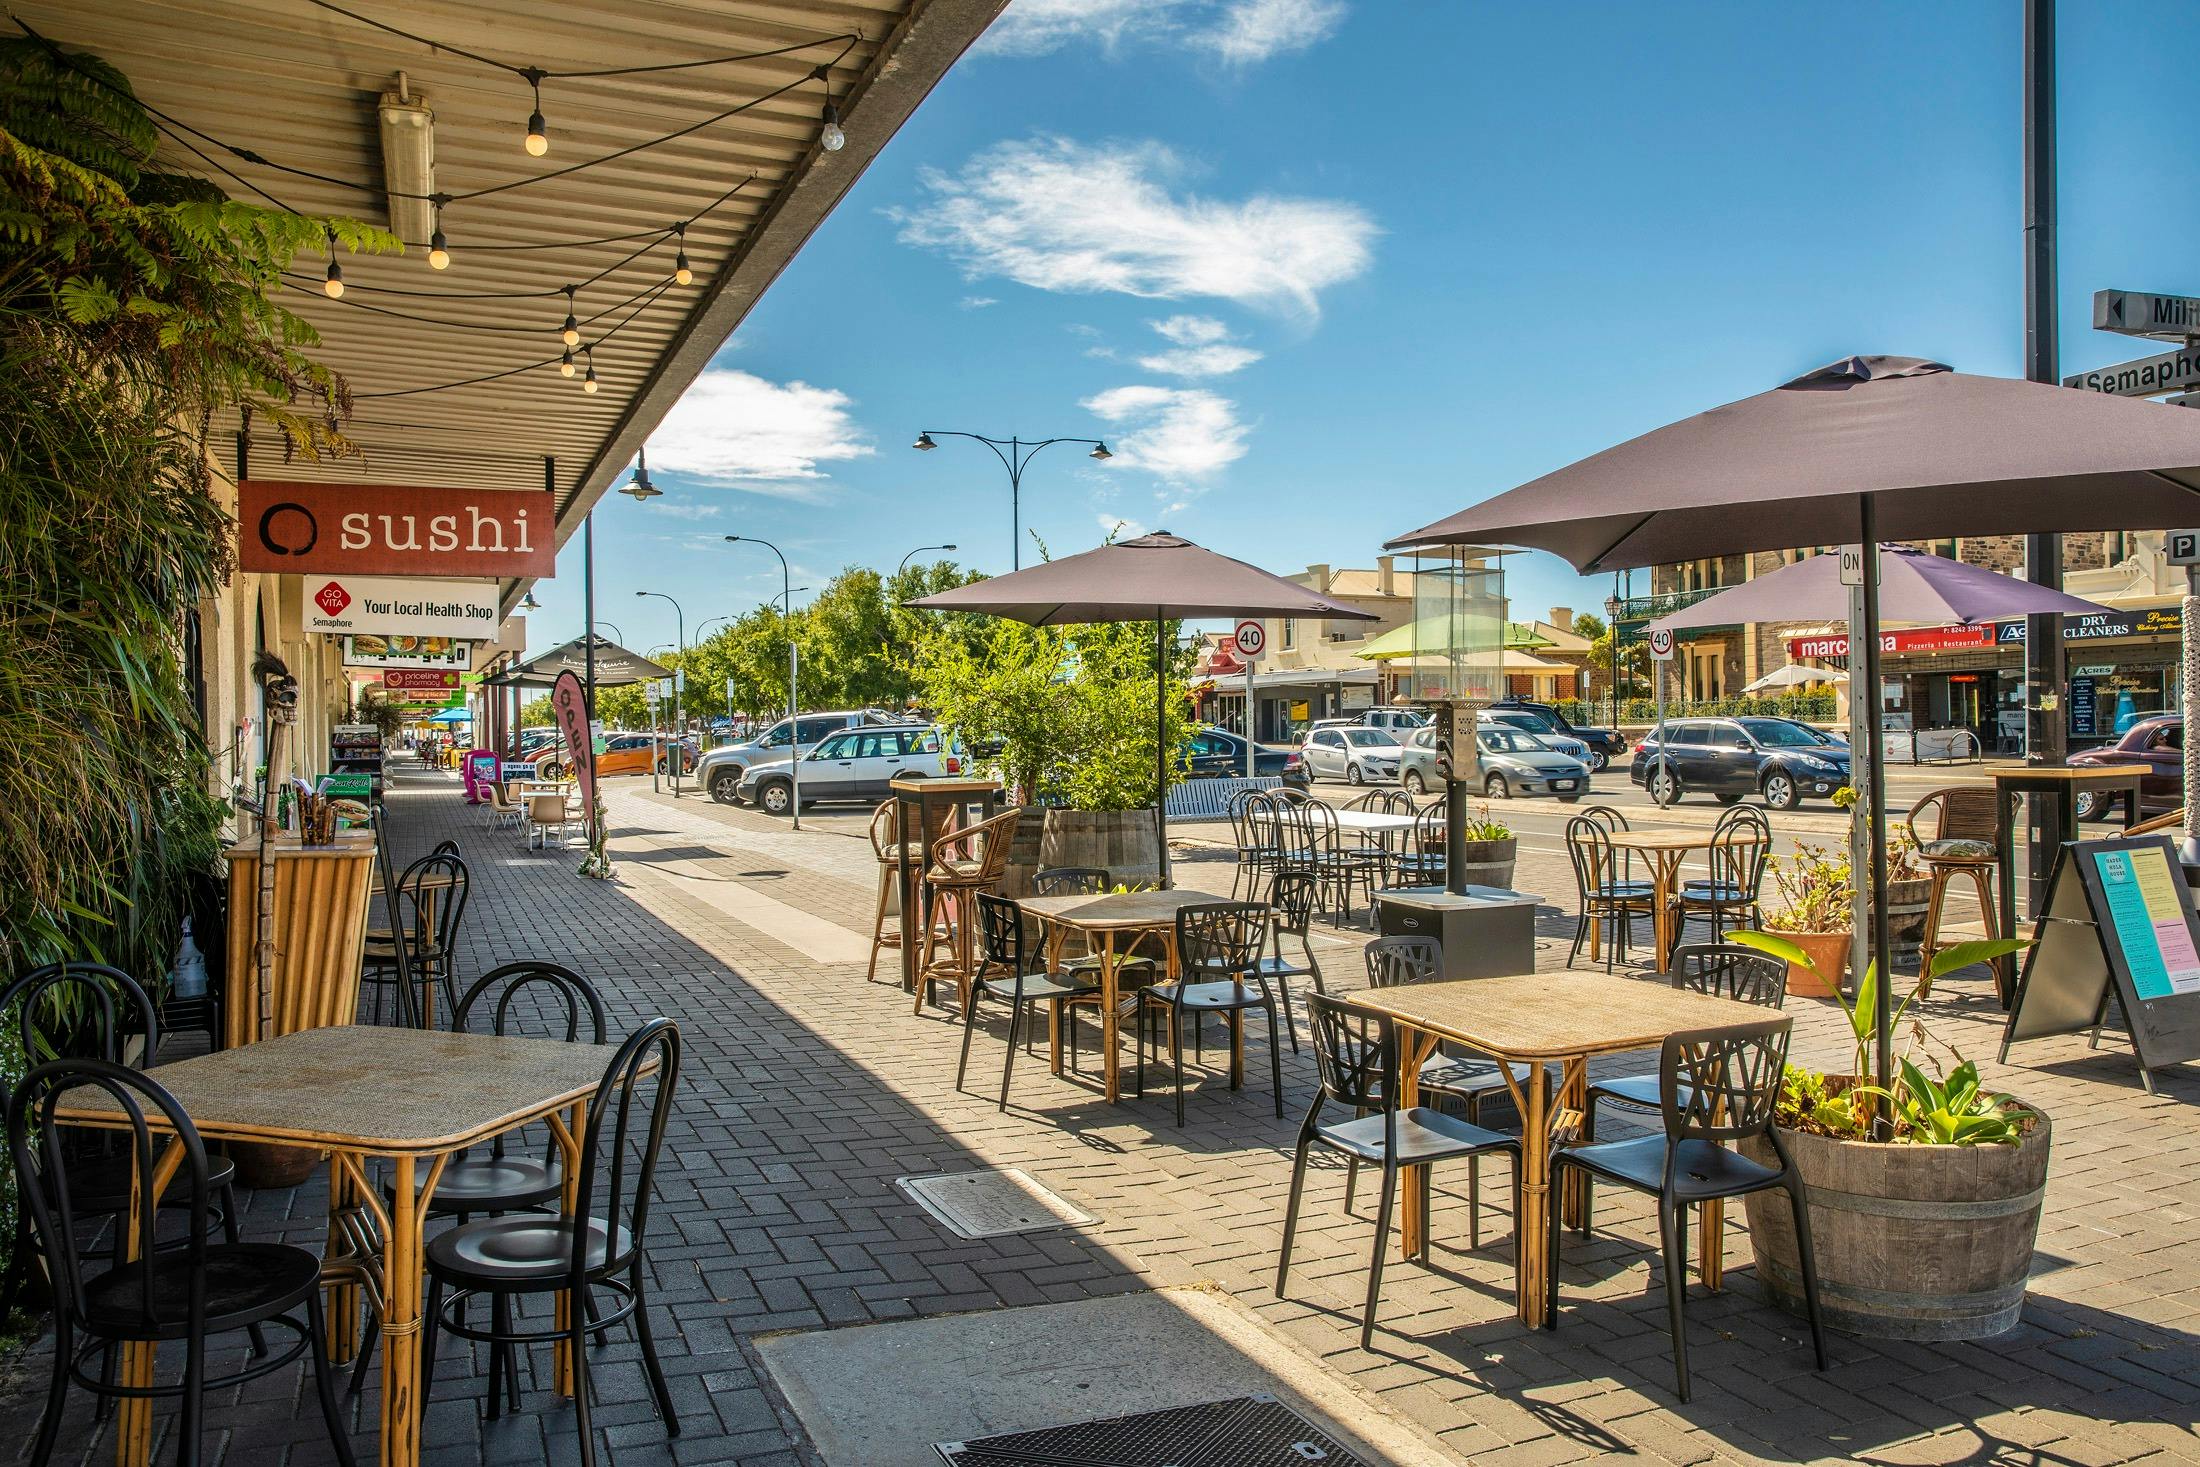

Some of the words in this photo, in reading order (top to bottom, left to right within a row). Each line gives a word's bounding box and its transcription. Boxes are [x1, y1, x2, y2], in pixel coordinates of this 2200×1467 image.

[340, 506, 534, 553] sushi
[2177, 537, 2192, 556] P
[323, 589, 342, 599] GO
[321, 599, 344, 608] VITA
[364, 599, 392, 615] Your
[394, 601, 423, 616] Local
[425, 602, 463, 618] Health
[465, 603, 493, 621] Shop
[312, 617, 353, 628] Semaphore
[2082, 616, 2108, 626] DRY
[2147, 612, 2179, 623] Precise
[2063, 625, 2129, 638] CLEANERS
[1239, 631, 1260, 646] 40
[1653, 633, 1669, 646] 40
[1943, 639, 1983, 648] Restaurant
[405, 673, 440, 681] priceline
[560, 688, 588, 776] OPEN
